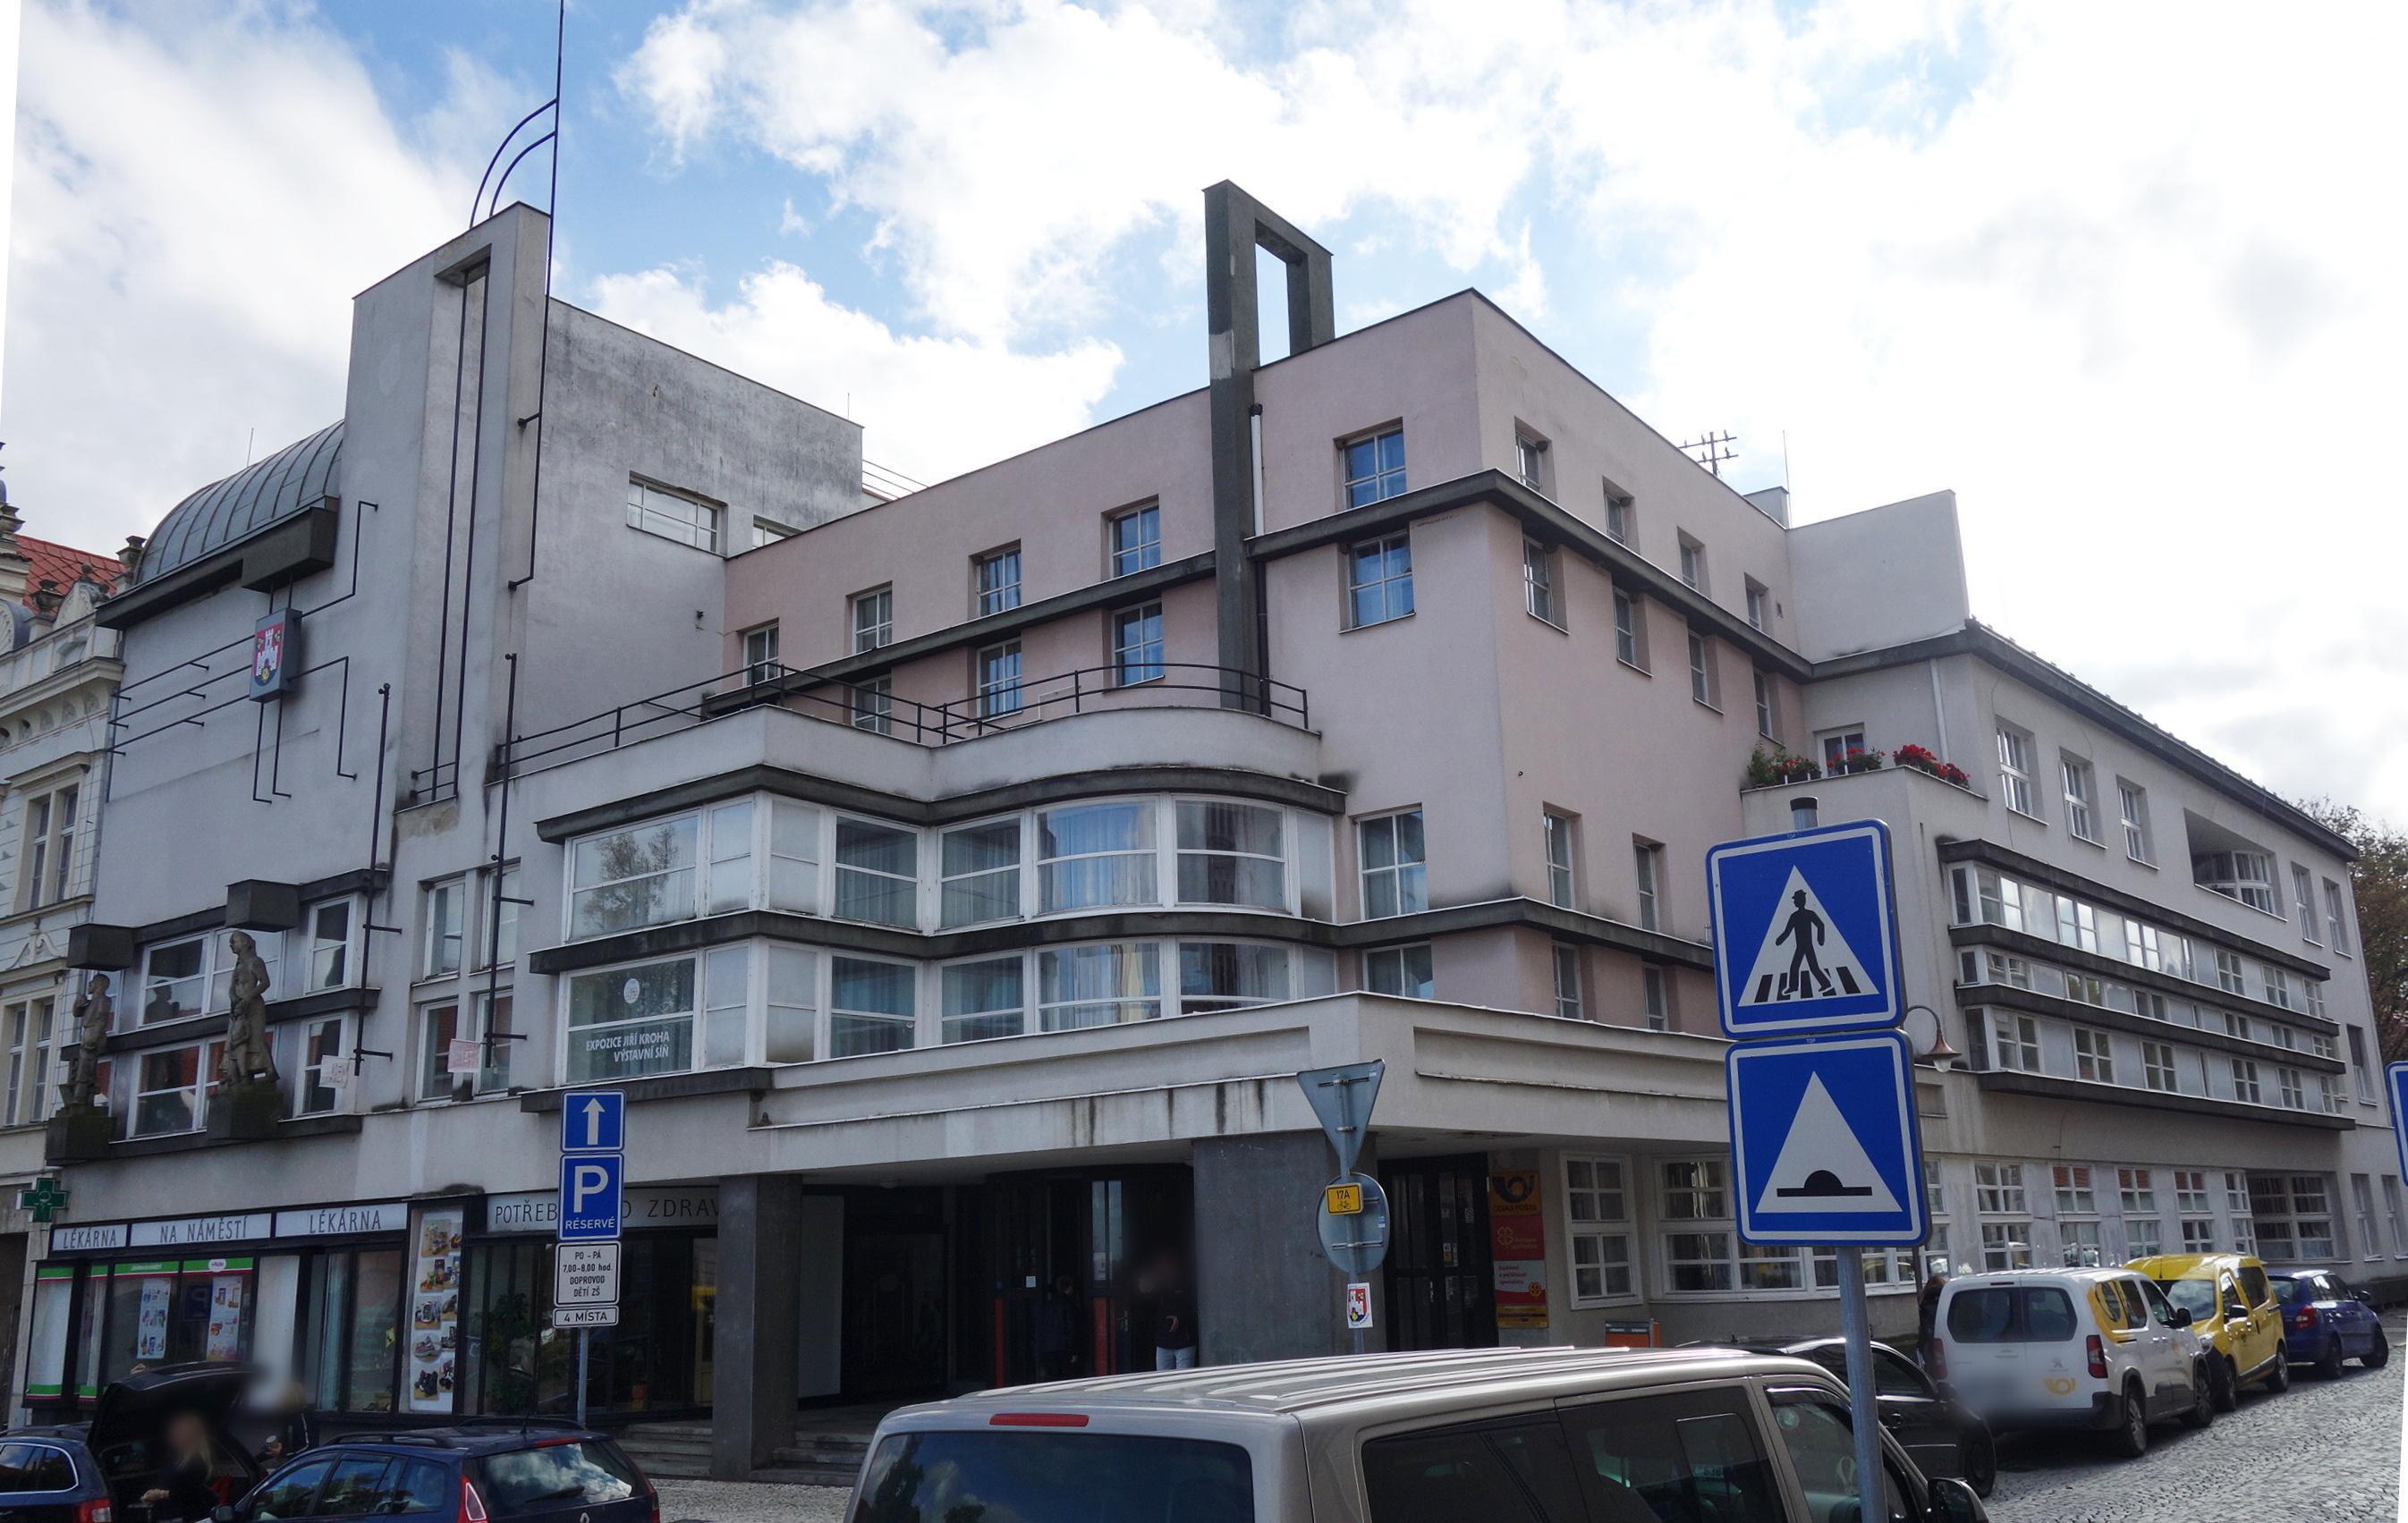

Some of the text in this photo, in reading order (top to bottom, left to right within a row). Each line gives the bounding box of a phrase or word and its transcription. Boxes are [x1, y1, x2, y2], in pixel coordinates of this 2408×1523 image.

[586, 1031, 670, 1052] EXPOZICE JIŘÍ KROHA
[614, 1045, 654, 1062] VÝSTAVNÍ
[573, 1165, 608, 1213] P
[1336, 1189, 1351, 1199] 17A
[496, 1199, 558, 1224] POTŘEB
[647, 1198, 718, 1217] ZDRAV
[309, 1208, 382, 1233] LÉKÁRNA
[565, 1215, 615, 1230] RÉSERVÉ
[63, 1227, 117, 1249] LÉKÁRNA
[160, 1216, 249, 1243] NA NÁMĚSTÍ
[574, 1251, 584, 1260] PO
[592, 1249, 601, 1259] PÁ
[570, 1275, 606, 1285] DOPROVOD
[573, 1285, 600, 1297] DĚTÍ ZŠ
[564, 1309, 607, 1323] 4 MÍSTA
